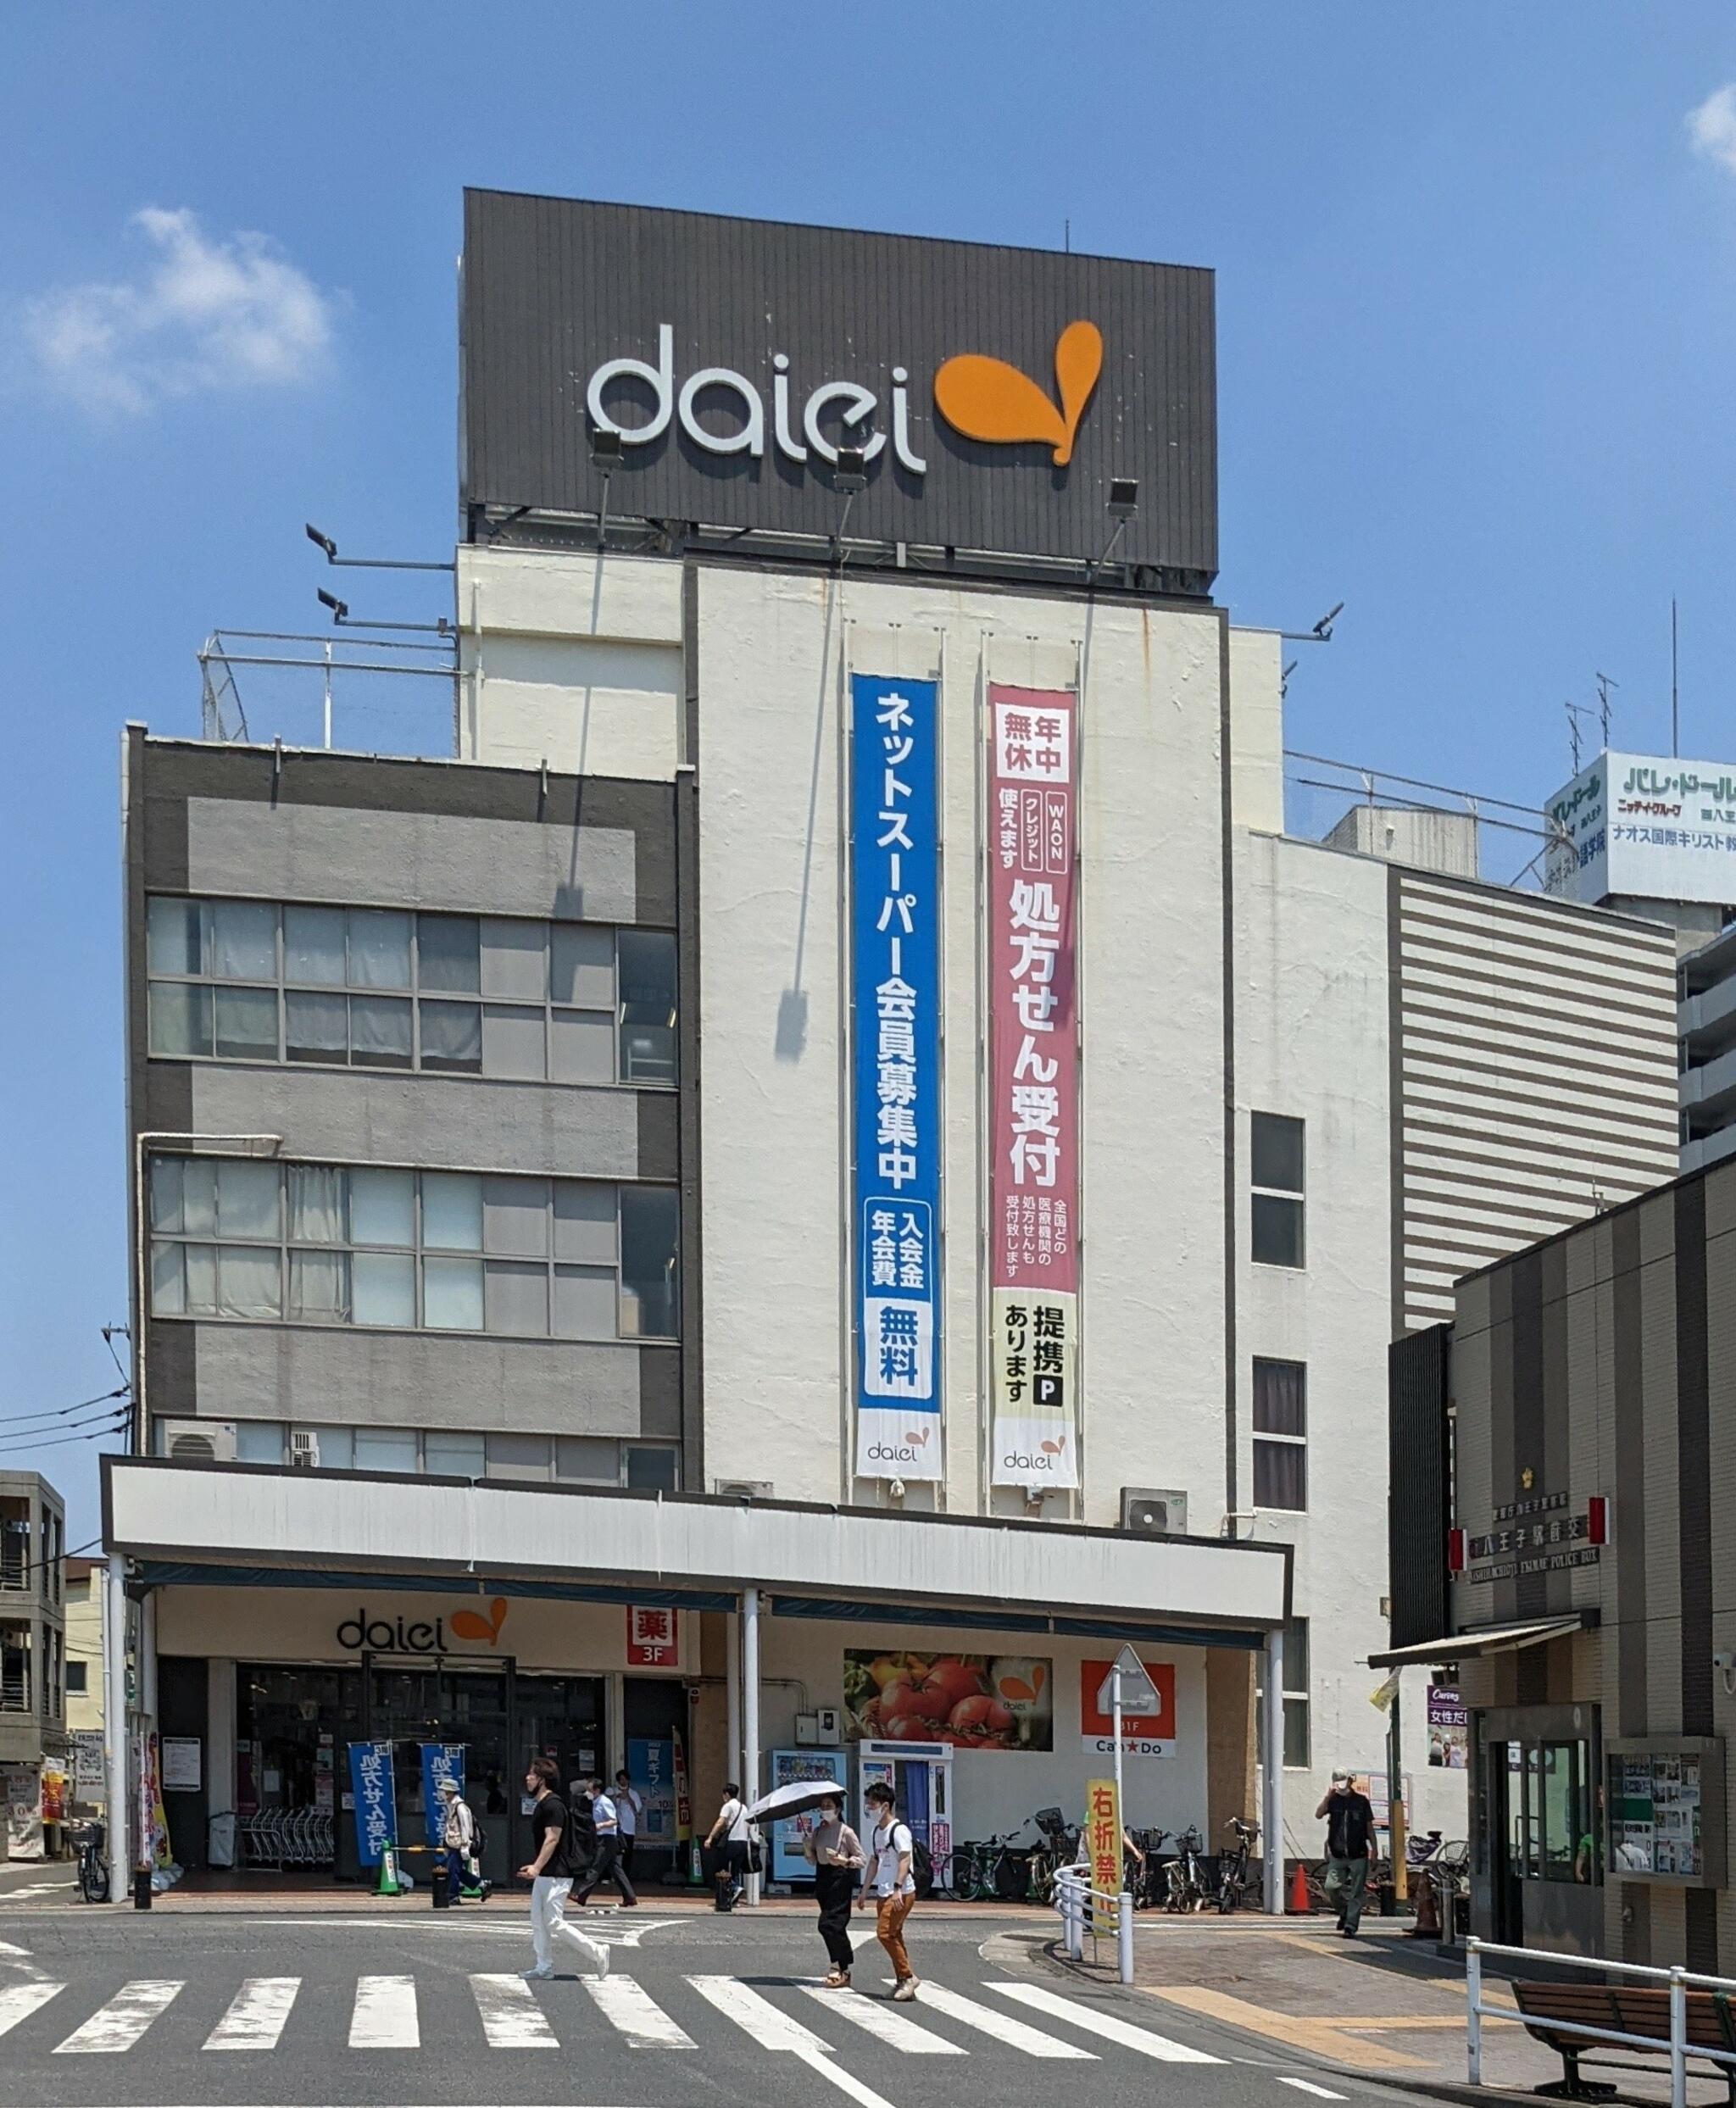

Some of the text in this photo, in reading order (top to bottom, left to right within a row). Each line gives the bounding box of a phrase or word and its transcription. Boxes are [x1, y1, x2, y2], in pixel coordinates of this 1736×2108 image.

[587, 323, 926, 475] daiei
[1004, 712, 1032, 771] 無休
[1035, 715, 1061, 774] 年中
[999, 787, 1019, 869] 使えます
[1026, 798, 1039, 863] クレジット
[1049, 804, 1064, 860] WAON
[876, 692, 918, 1190] ネットスーパー会員募集中
[1009, 878, 1061, 1187] 処方せん受付
[871, 1210, 896, 1288] 年会費
[899, 1212, 924, 1289] 入会金
[1006, 1195, 1019, 1278] 受付致します
[1022, 1196, 1035, 1265] 処方せんも
[1038, 1197, 1051, 1265] 医療機関の
[1054, 1200, 1067, 1254] 全国どの
[880, 1305, 918, 1387] 無料
[1005, 1304, 1027, 1403] あります
[867, 1442, 917, 1462] daiei
[1003, 1450, 1053, 1471] daiei
[1551, 1553, 1577, 1569] POLICE
[1581, 1549, 1597, 1562] BOX
[337, 1608, 448, 1653] daiei
[637, 1610, 667, 1640] 薬
[643, 1646, 663, 1661] 3F
